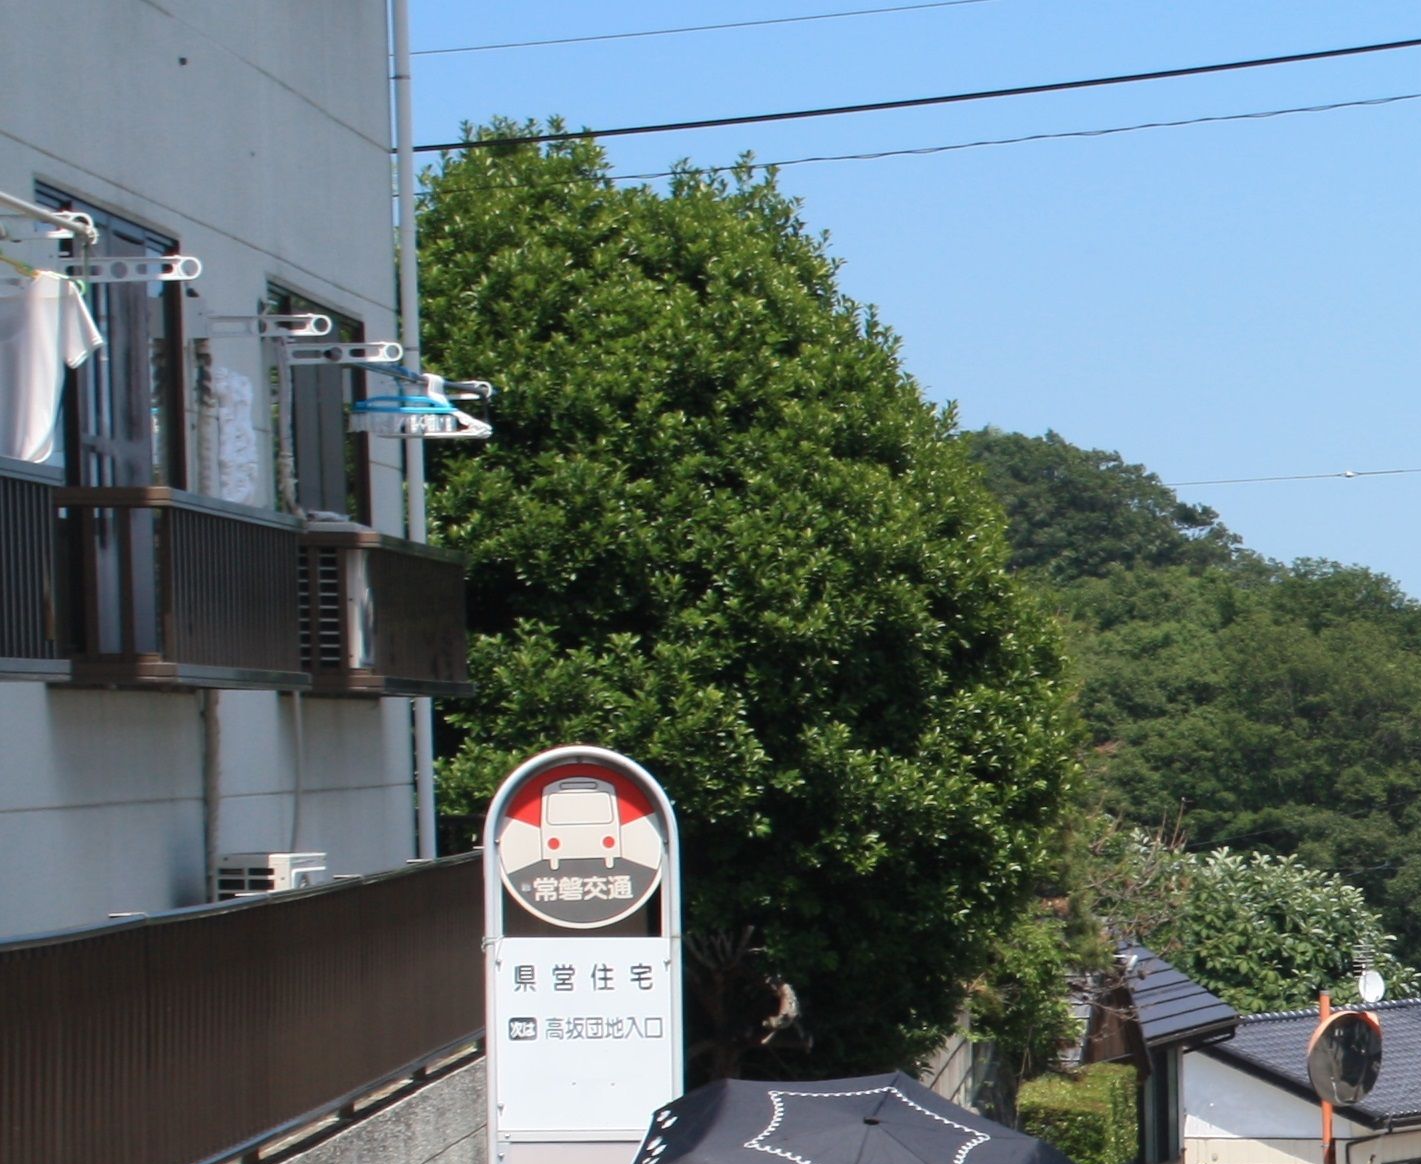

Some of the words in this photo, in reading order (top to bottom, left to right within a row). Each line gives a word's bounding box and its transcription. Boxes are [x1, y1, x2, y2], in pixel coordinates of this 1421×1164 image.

[533, 875, 633, 902] 常磐交通
[513, 963, 654, 992] 県営住宅
[545, 1017, 664, 1040] 高坂団地入口
